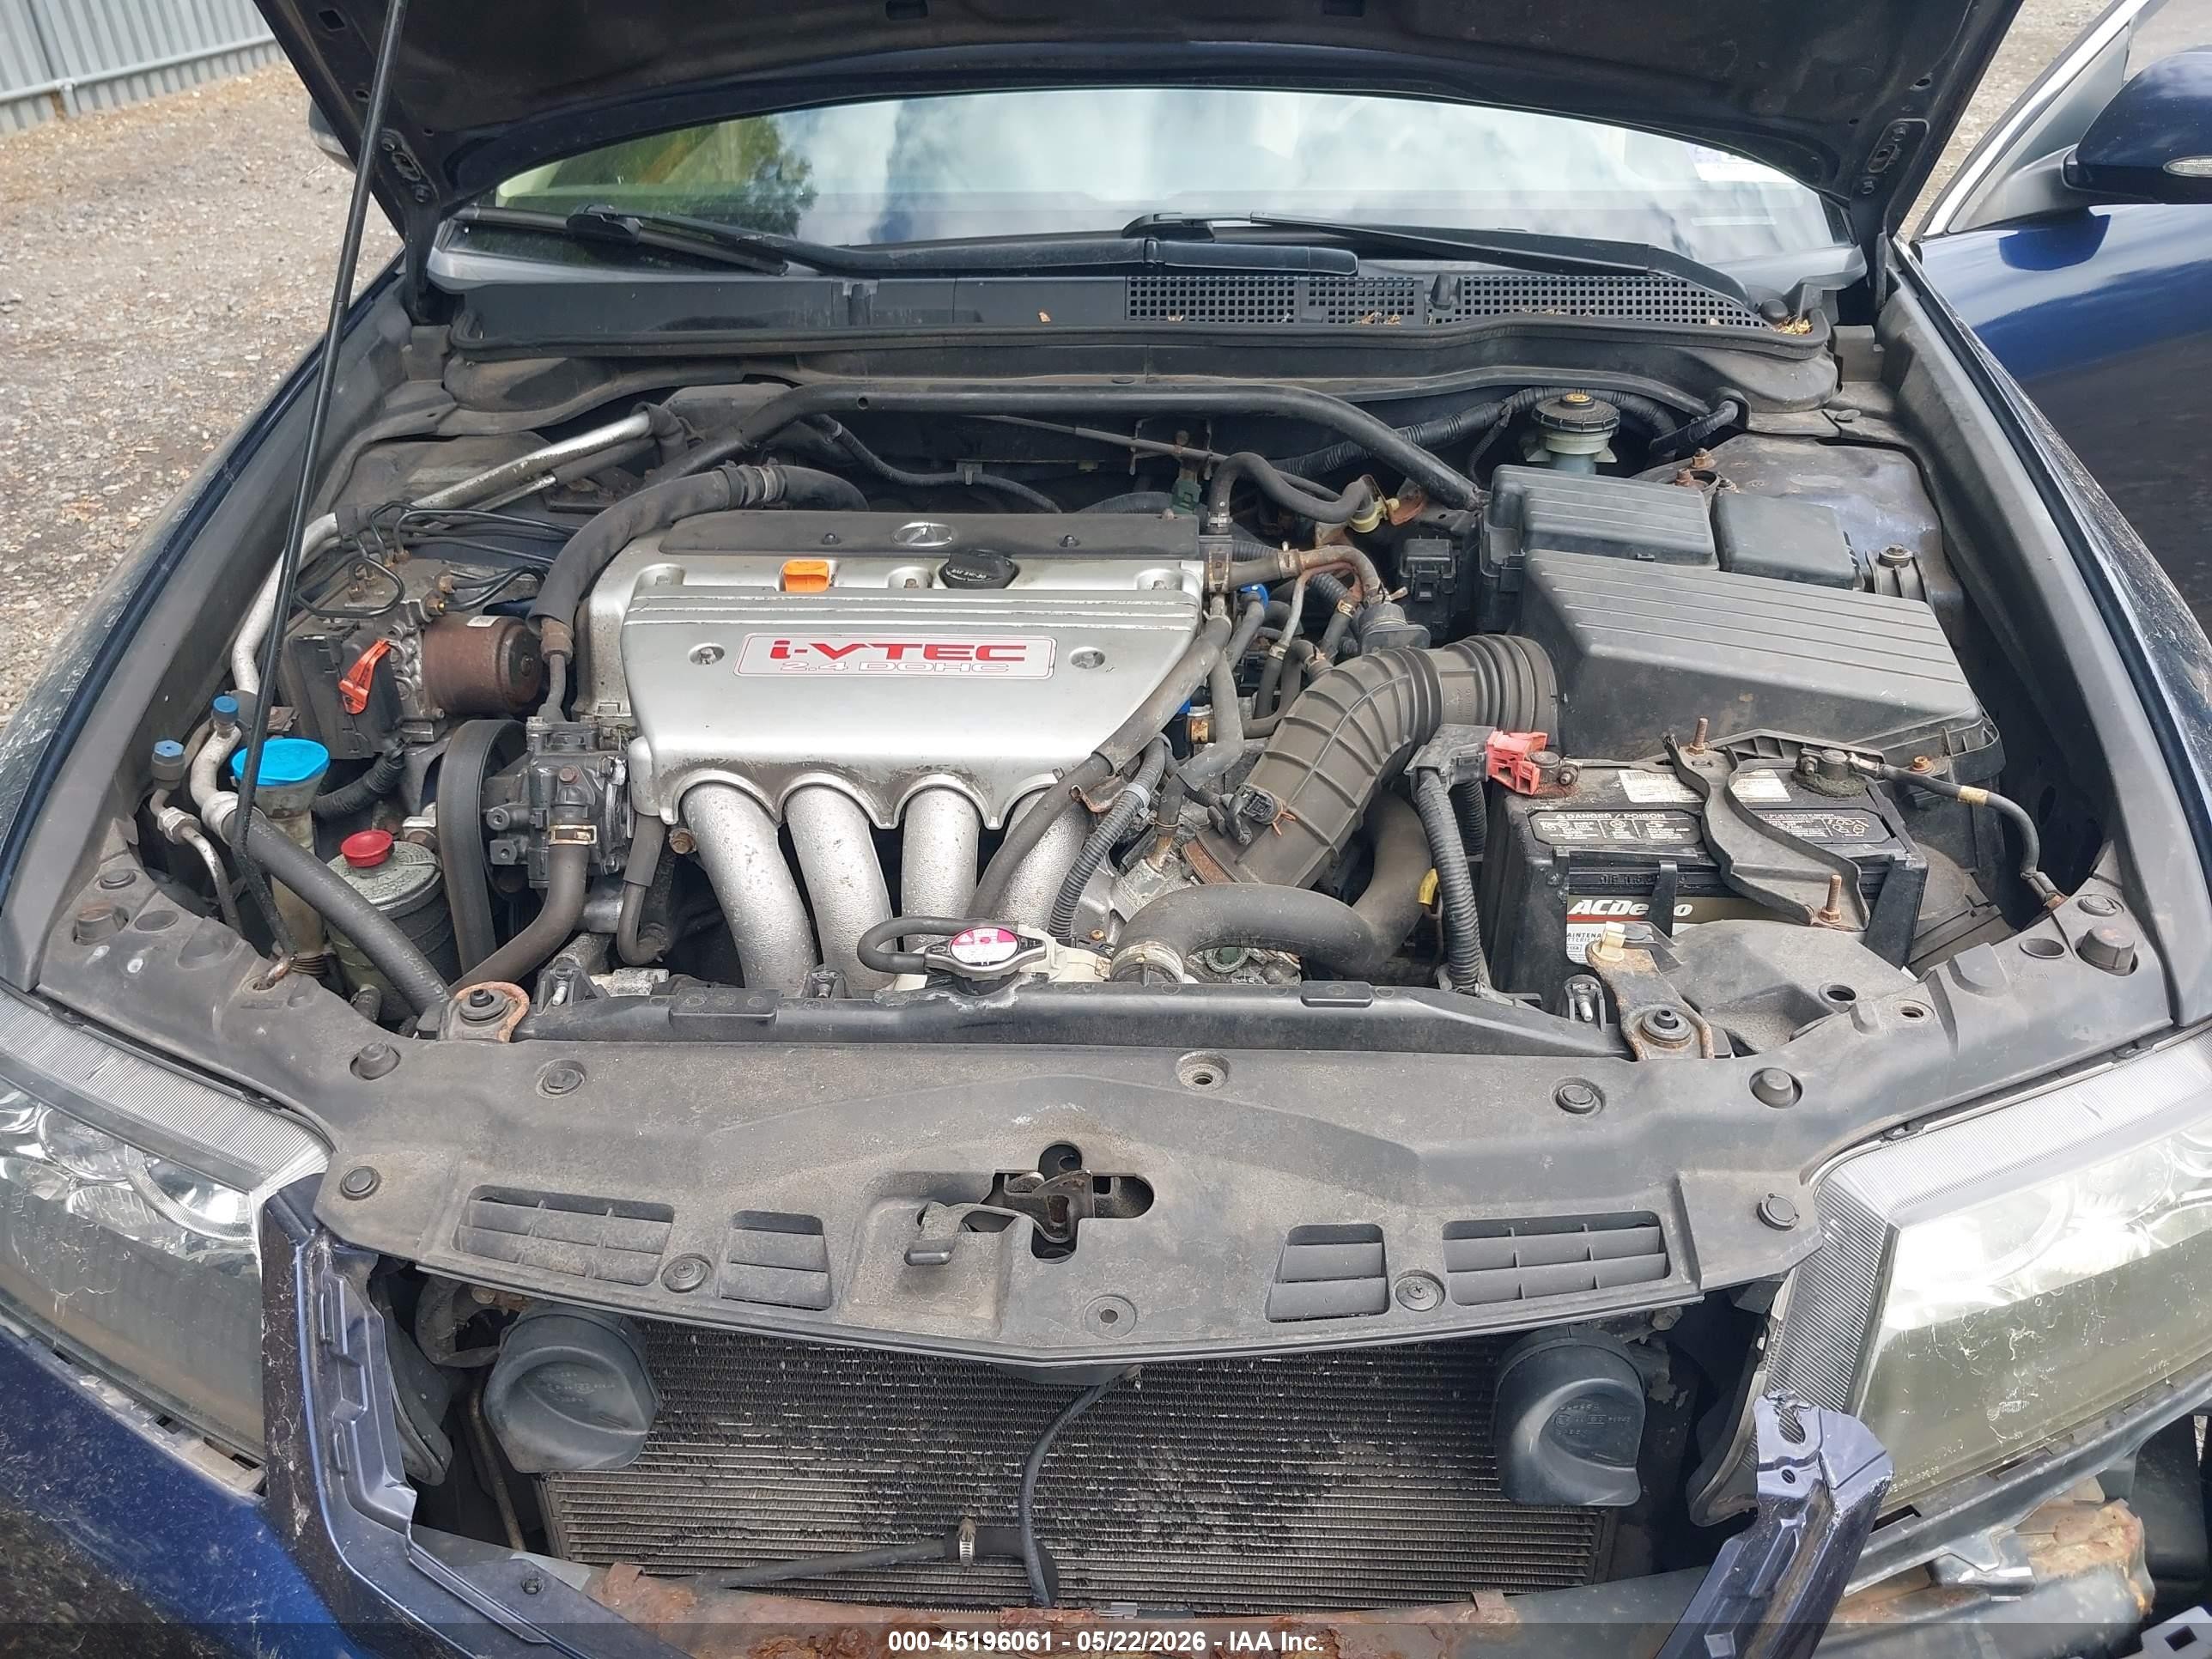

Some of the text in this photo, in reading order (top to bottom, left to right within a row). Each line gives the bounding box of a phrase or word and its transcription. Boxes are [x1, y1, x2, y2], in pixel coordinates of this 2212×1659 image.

[770, 640, 1026, 661] i-VTEC
[781, 661, 1009, 672] 2.4 DOHC
[1568, 900, 1693, 917] ACDeo
